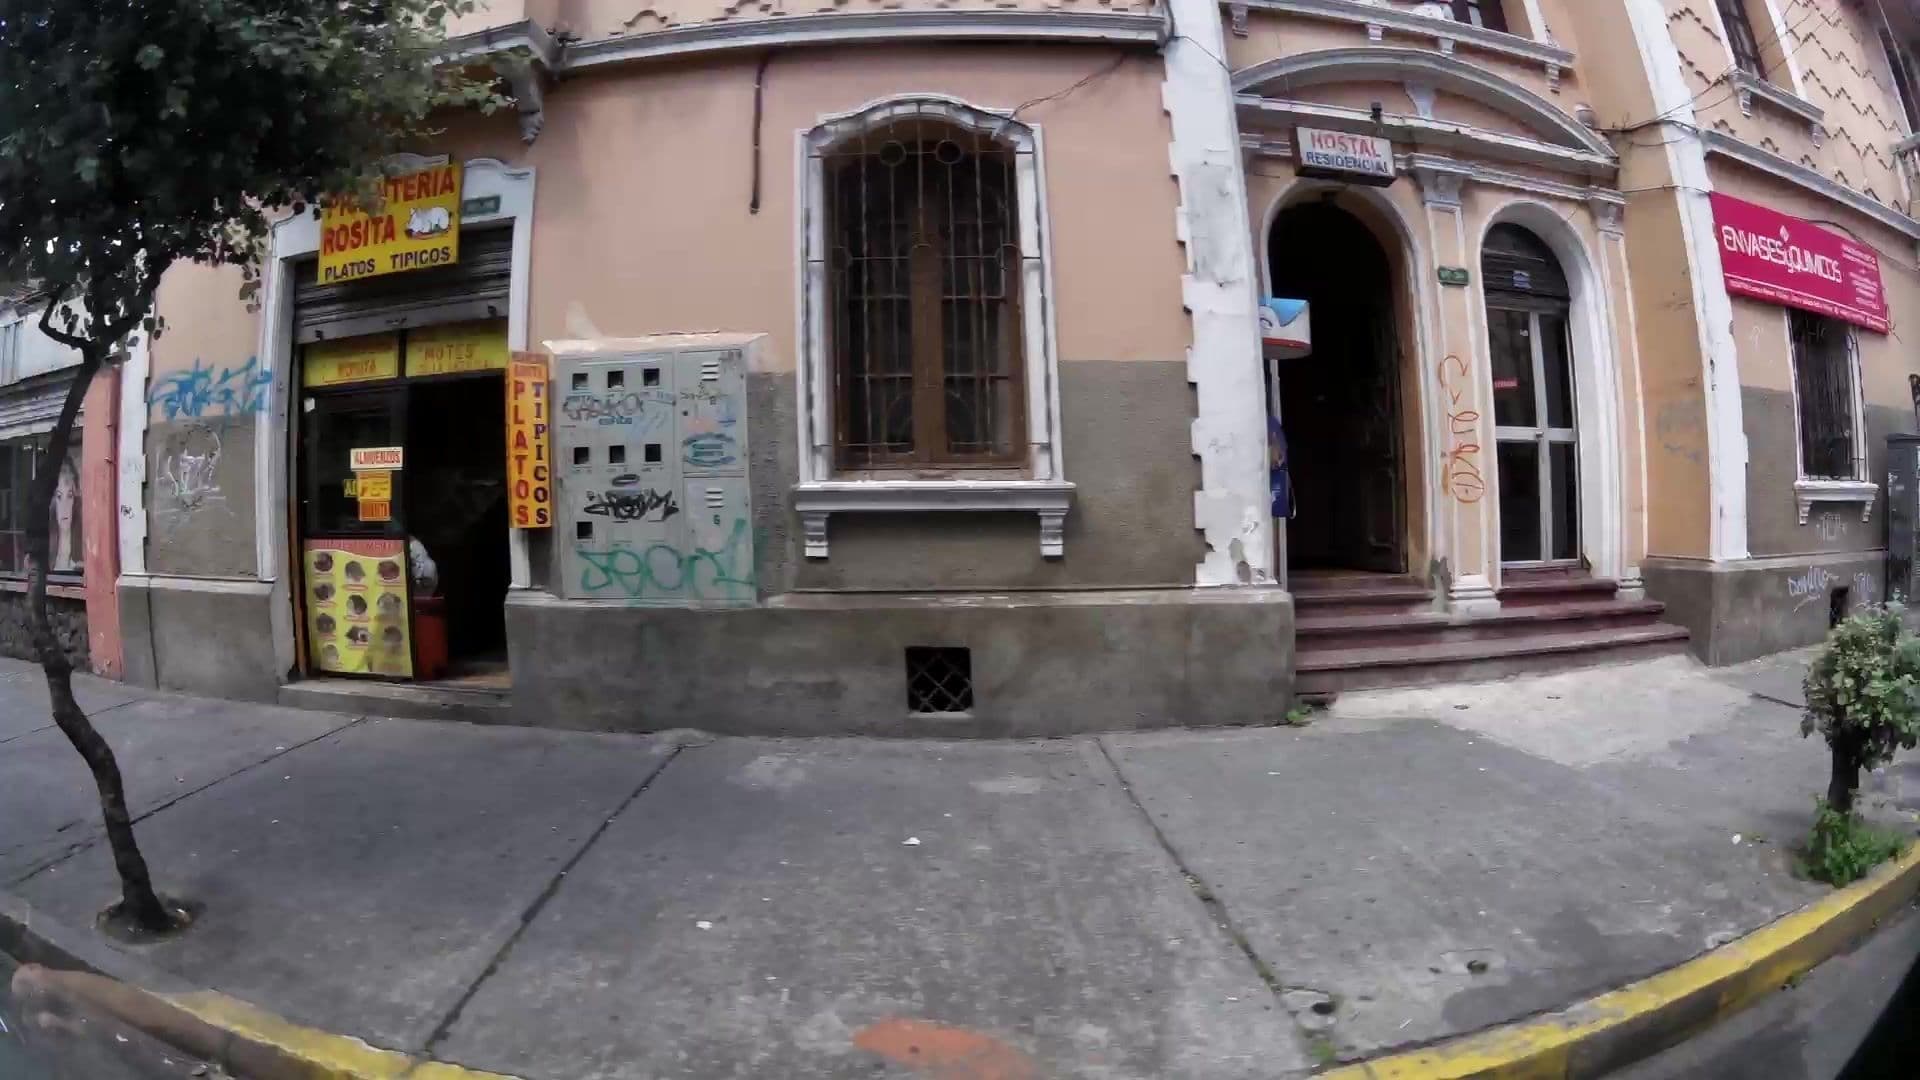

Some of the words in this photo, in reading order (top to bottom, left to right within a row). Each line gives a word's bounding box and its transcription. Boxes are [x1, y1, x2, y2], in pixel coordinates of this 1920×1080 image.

[1305, 151, 1388, 173] RESIDENCIAL
[1311, 131, 1382, 158] HOSTAL
[323, 214, 396, 257] ROSITA
[1721, 225, 1785, 265] ENVASES
[324, 258, 376, 281] PLATOS
[390, 246, 451, 269] TIPICOS
[513, 379, 530, 525] PLATOS
[532, 381, 549, 525] TIPICOS
